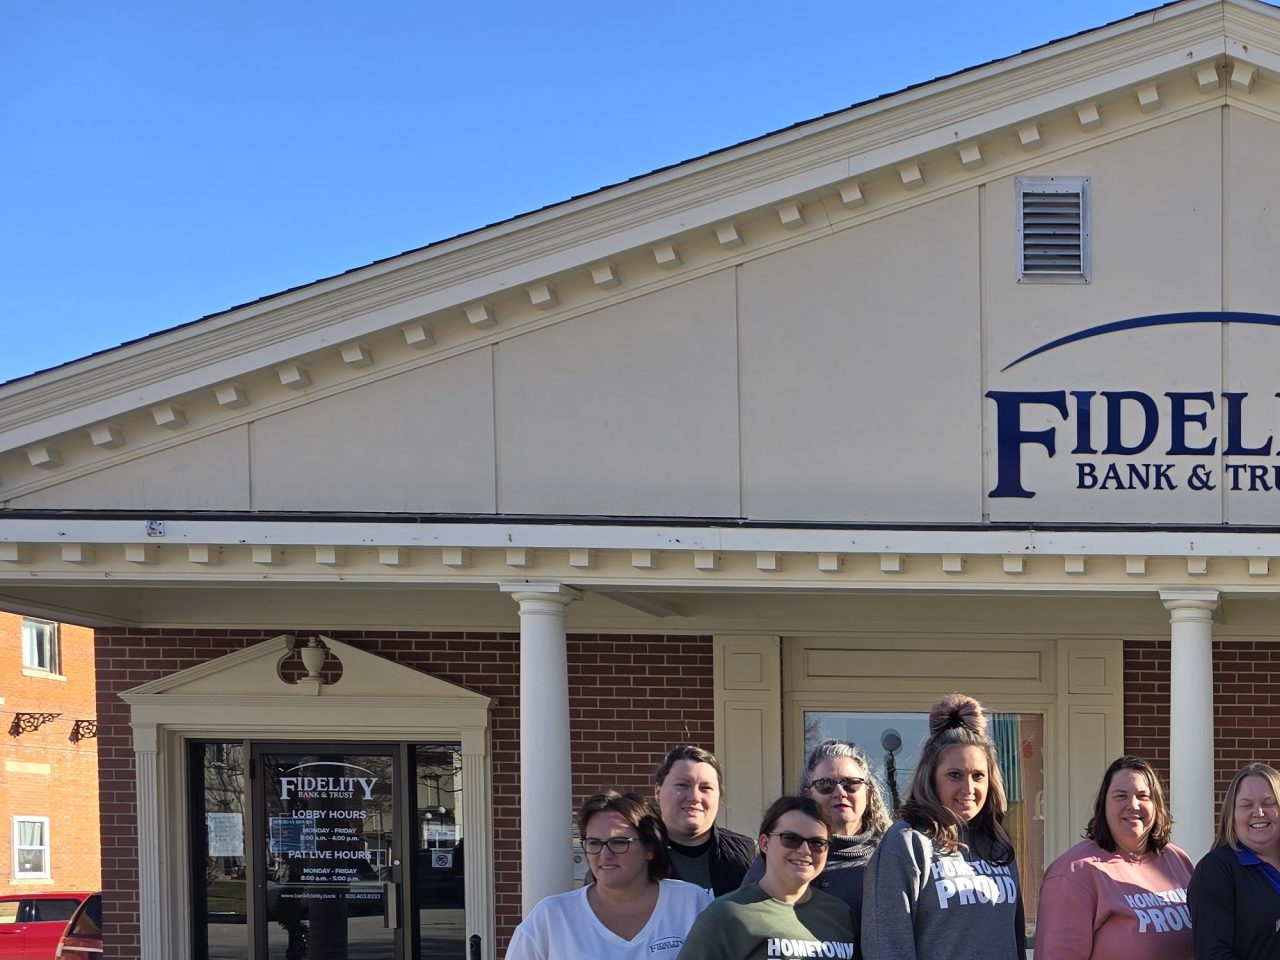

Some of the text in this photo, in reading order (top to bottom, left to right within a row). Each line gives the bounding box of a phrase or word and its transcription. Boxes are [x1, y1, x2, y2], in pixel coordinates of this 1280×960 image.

[1075, 462, 1178, 490] BANK
[1186, 464, 1217, 491] &
[279, 776, 379, 800] FIDELITY
[298, 791, 320, 799] BANK
[330, 791, 354, 799] TRUST
[292, 810, 367, 819] LOBBY HOURS
[288, 850, 372, 860] PAT LIVE HOURS
[934, 875, 1017, 909] PROUD
[1123, 887, 1188, 908] HOMETOW
[1133, 904, 1193, 933] PROU
[767, 937, 854, 960] HOMETOWN
